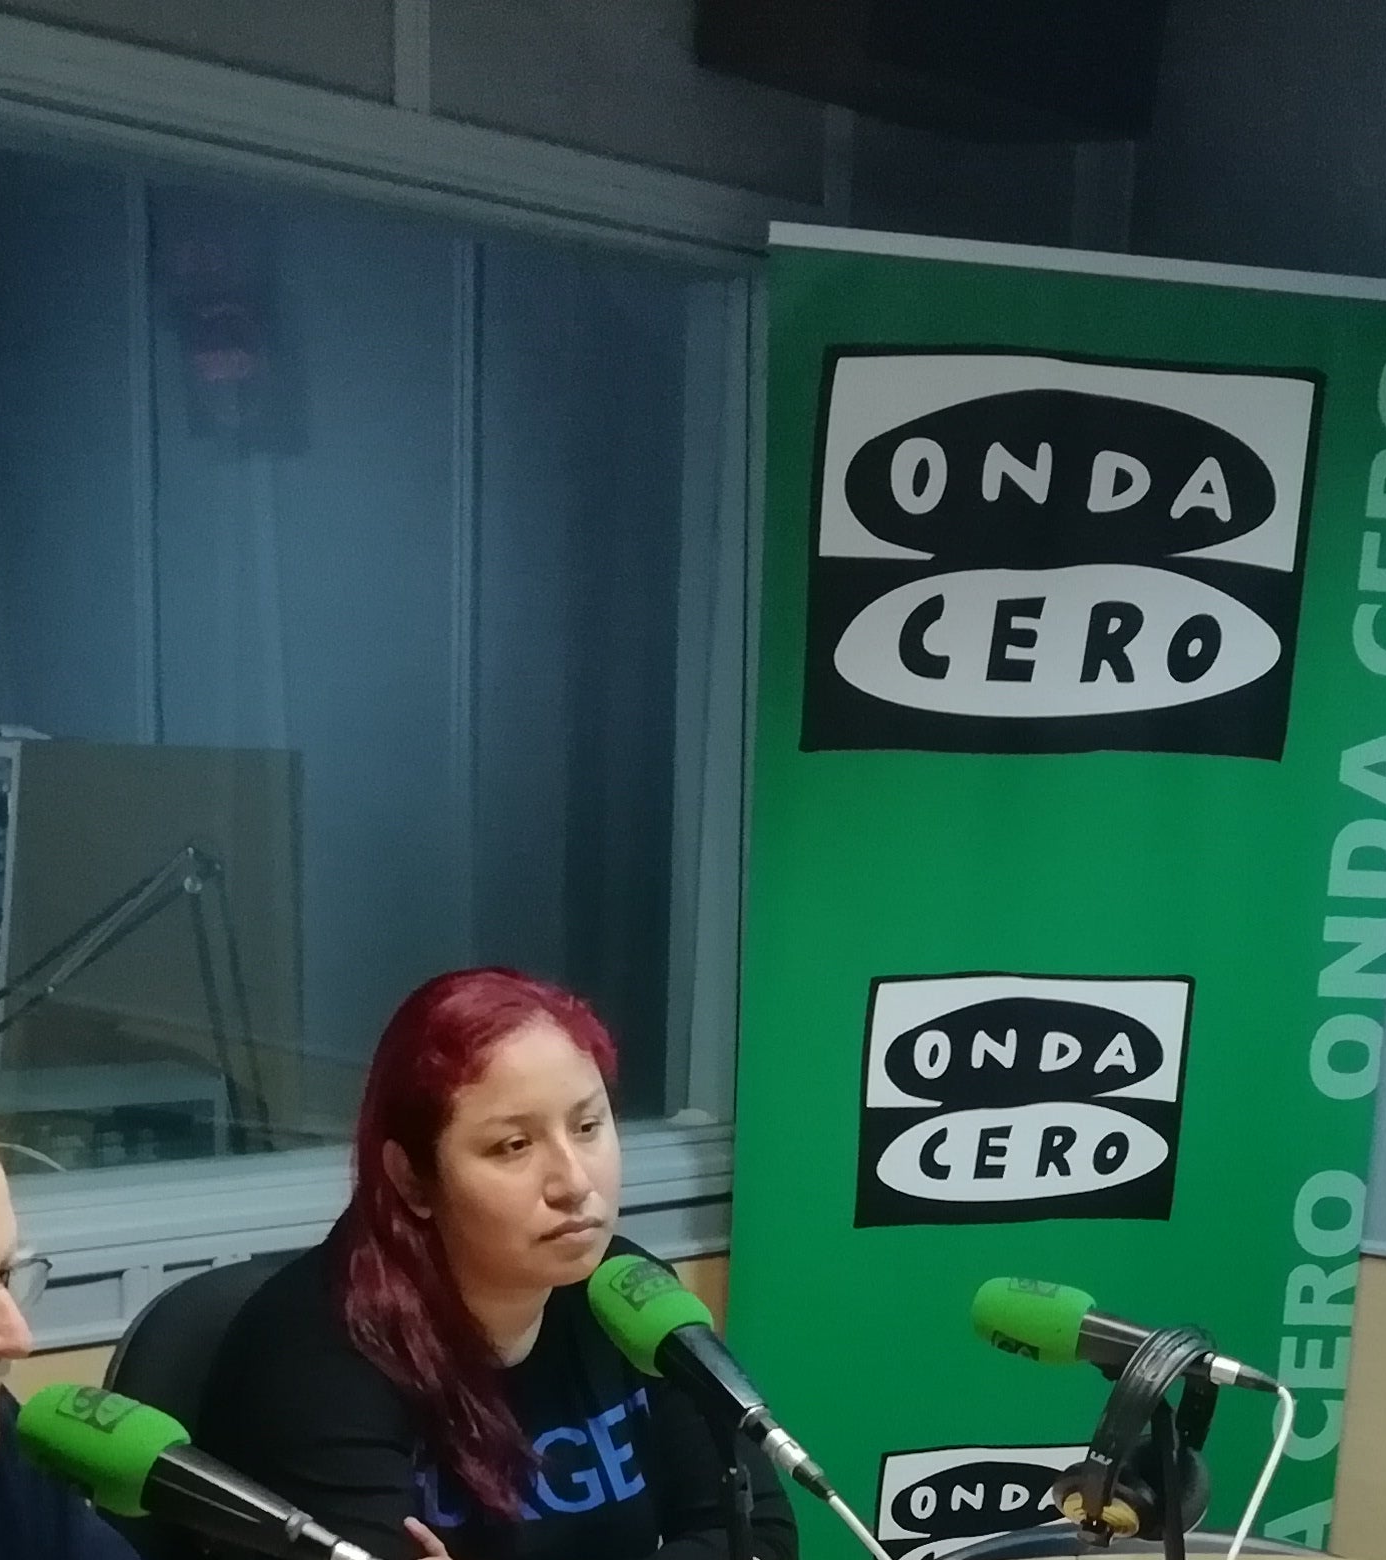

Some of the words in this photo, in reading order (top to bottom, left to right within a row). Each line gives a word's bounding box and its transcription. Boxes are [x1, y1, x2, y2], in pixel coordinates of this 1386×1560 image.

[889, 436, 1233, 523] ONDA
[898, 594, 1223, 685] CERO
[913, 1029, 1137, 1080] ONDA
[918, 1125, 1130, 1180] CERO
[1265, 1169, 1368, 1462] CERO
